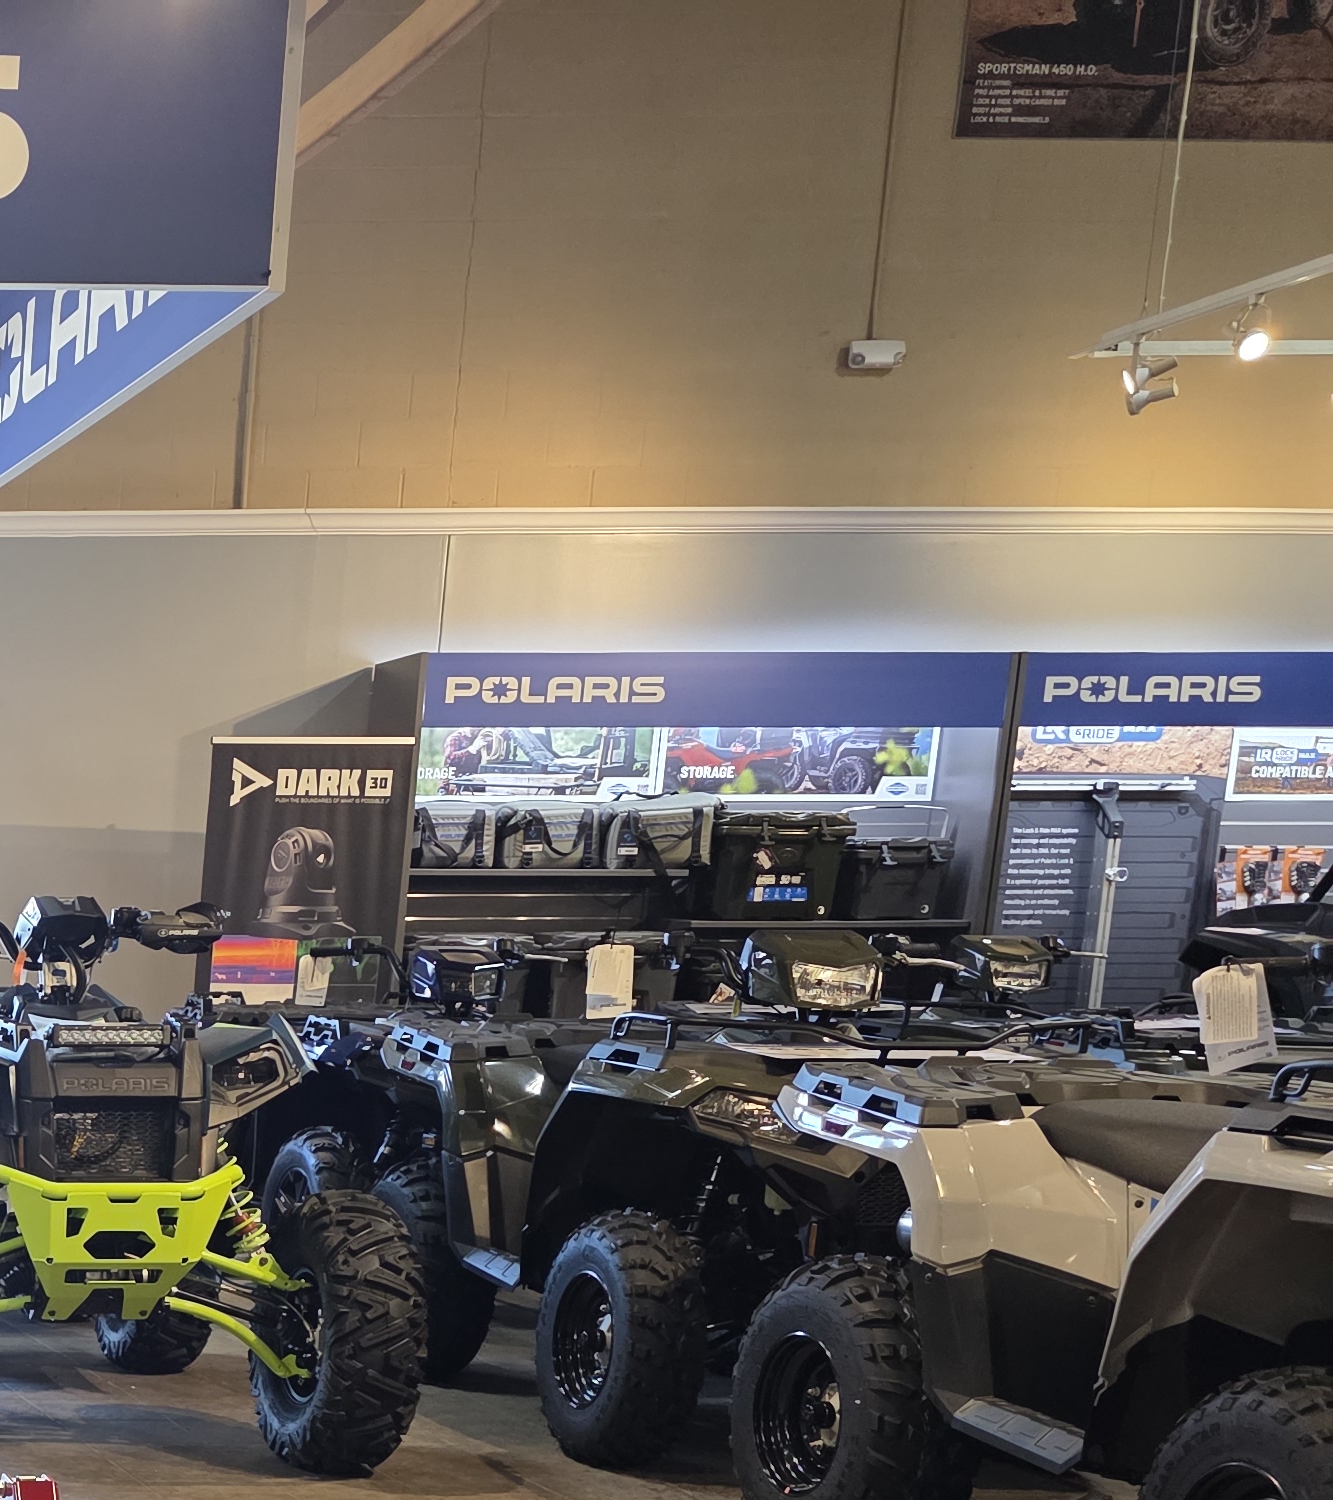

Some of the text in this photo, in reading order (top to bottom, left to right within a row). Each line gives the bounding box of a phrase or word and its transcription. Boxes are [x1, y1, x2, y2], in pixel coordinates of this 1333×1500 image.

[977, 63, 1099, 76] SPORTSMAN 450 H.O.
[445, 676, 666, 704] POLARIS
[1043, 676, 1262, 703] POLARIS
[417, 766, 456, 779] ORAGE
[680, 766, 735, 779] STORAGE
[1251, 765, 1325, 778] COMPATIBLE
[275, 768, 388, 796] DARK 30
[1227, 1041, 1269, 1056] POLARIS
[63, 1077, 170, 1092] POLARIS
